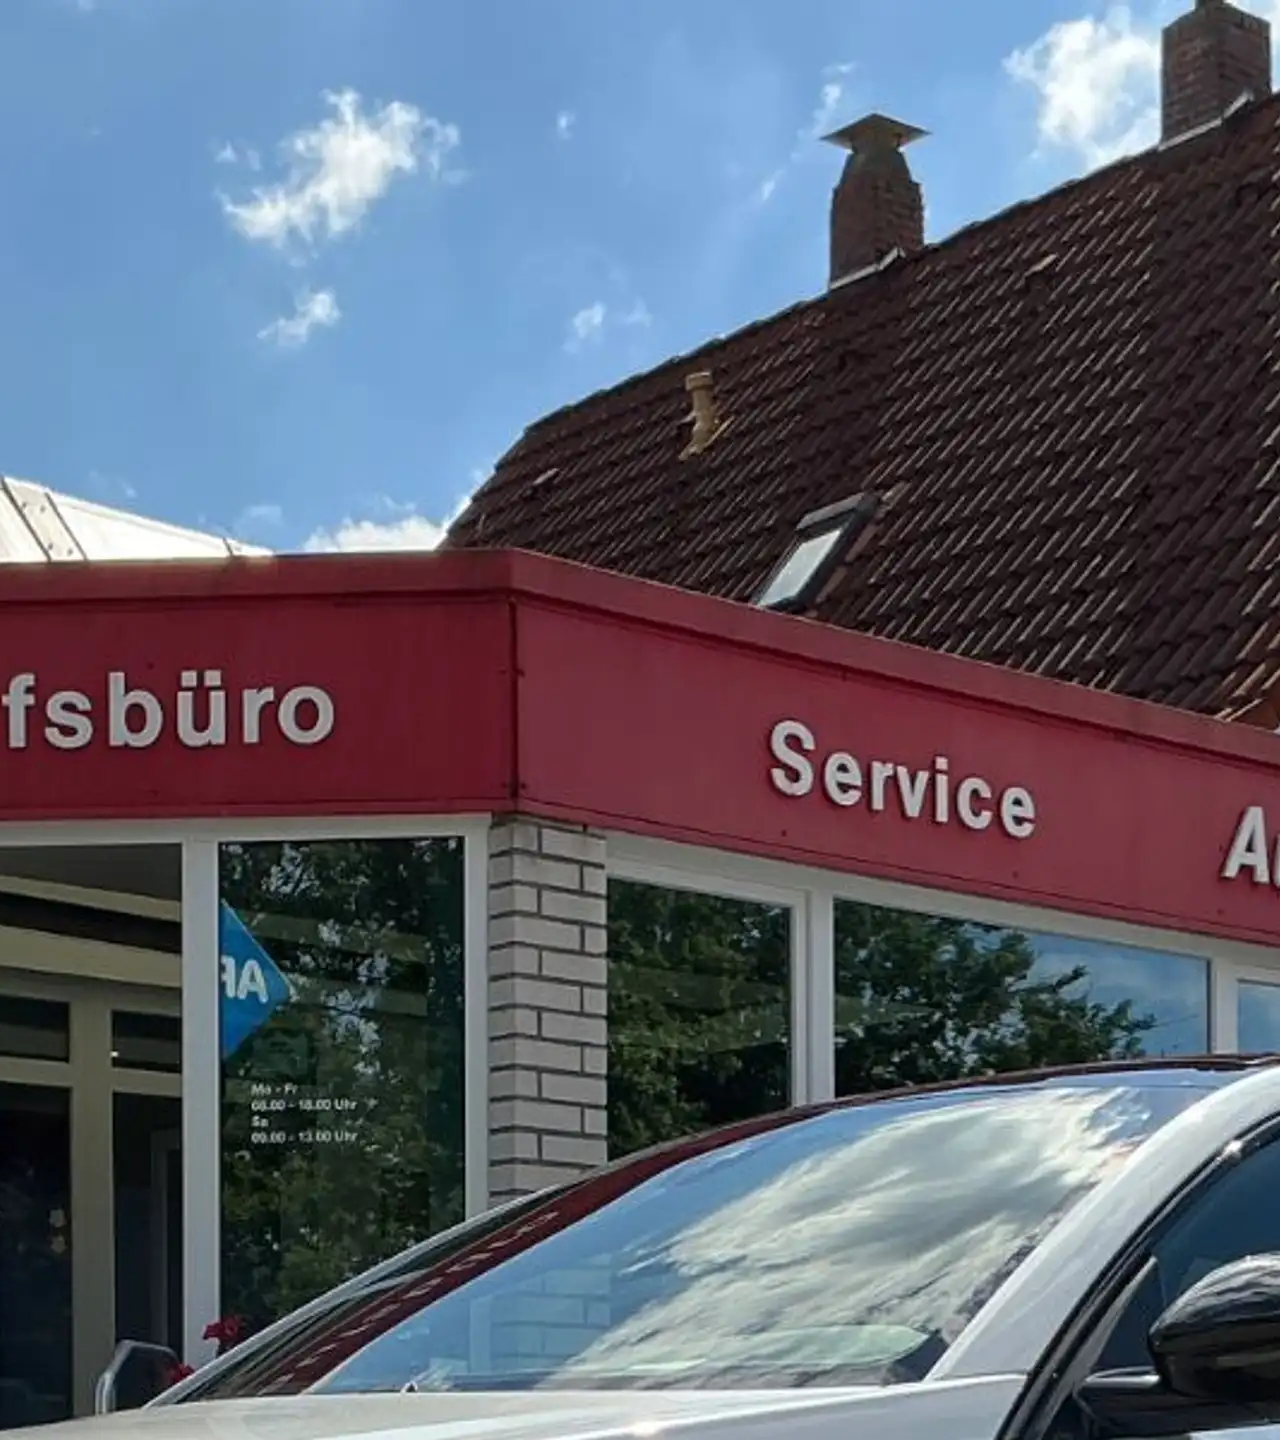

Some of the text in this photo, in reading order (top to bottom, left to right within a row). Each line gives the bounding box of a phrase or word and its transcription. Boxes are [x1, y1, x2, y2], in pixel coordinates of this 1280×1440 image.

[770, 720, 1037, 839] Service
[334, 1099, 358, 1110] Uhr
[334, 1130, 358, 1142] Uhr
